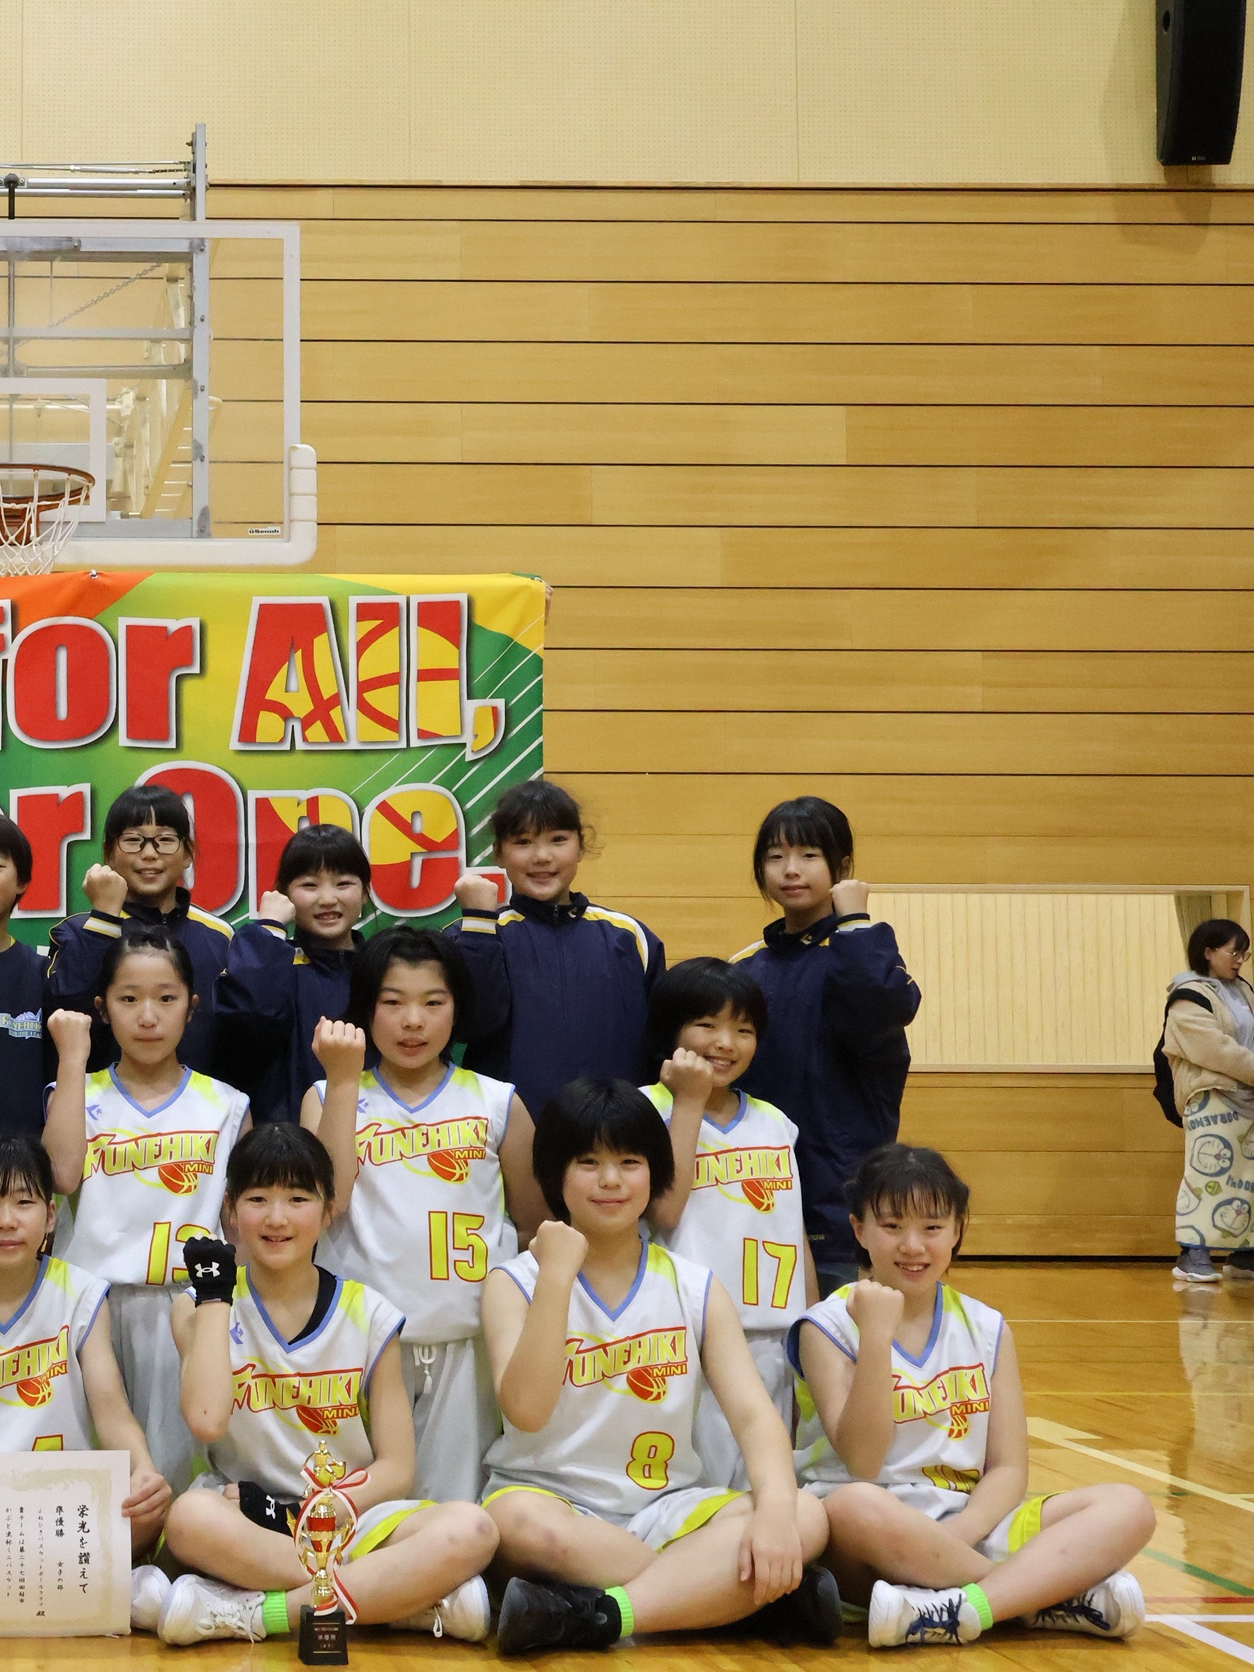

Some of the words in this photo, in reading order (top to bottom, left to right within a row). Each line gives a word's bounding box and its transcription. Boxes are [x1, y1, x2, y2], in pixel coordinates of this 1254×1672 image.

[230, 593, 506, 761] All,
[81, 1130, 220, 1182] FUNEHIKI
[184, 1163, 214, 1175] MINI
[454, 1149, 486, 1160] MINI
[692, 1145, 793, 1191] UNEHIKI
[763, 1180, 793, 1190] MINI
[428, 1211, 488, 1282] 15
[742, 1237, 797, 1309] 17
[652, 1365, 687, 1378] MINI
[891, 1362, 991, 1424] UNEIKI
[951, 1400, 989, 1415] MINI
[626, 1431, 675, 1491] 8
